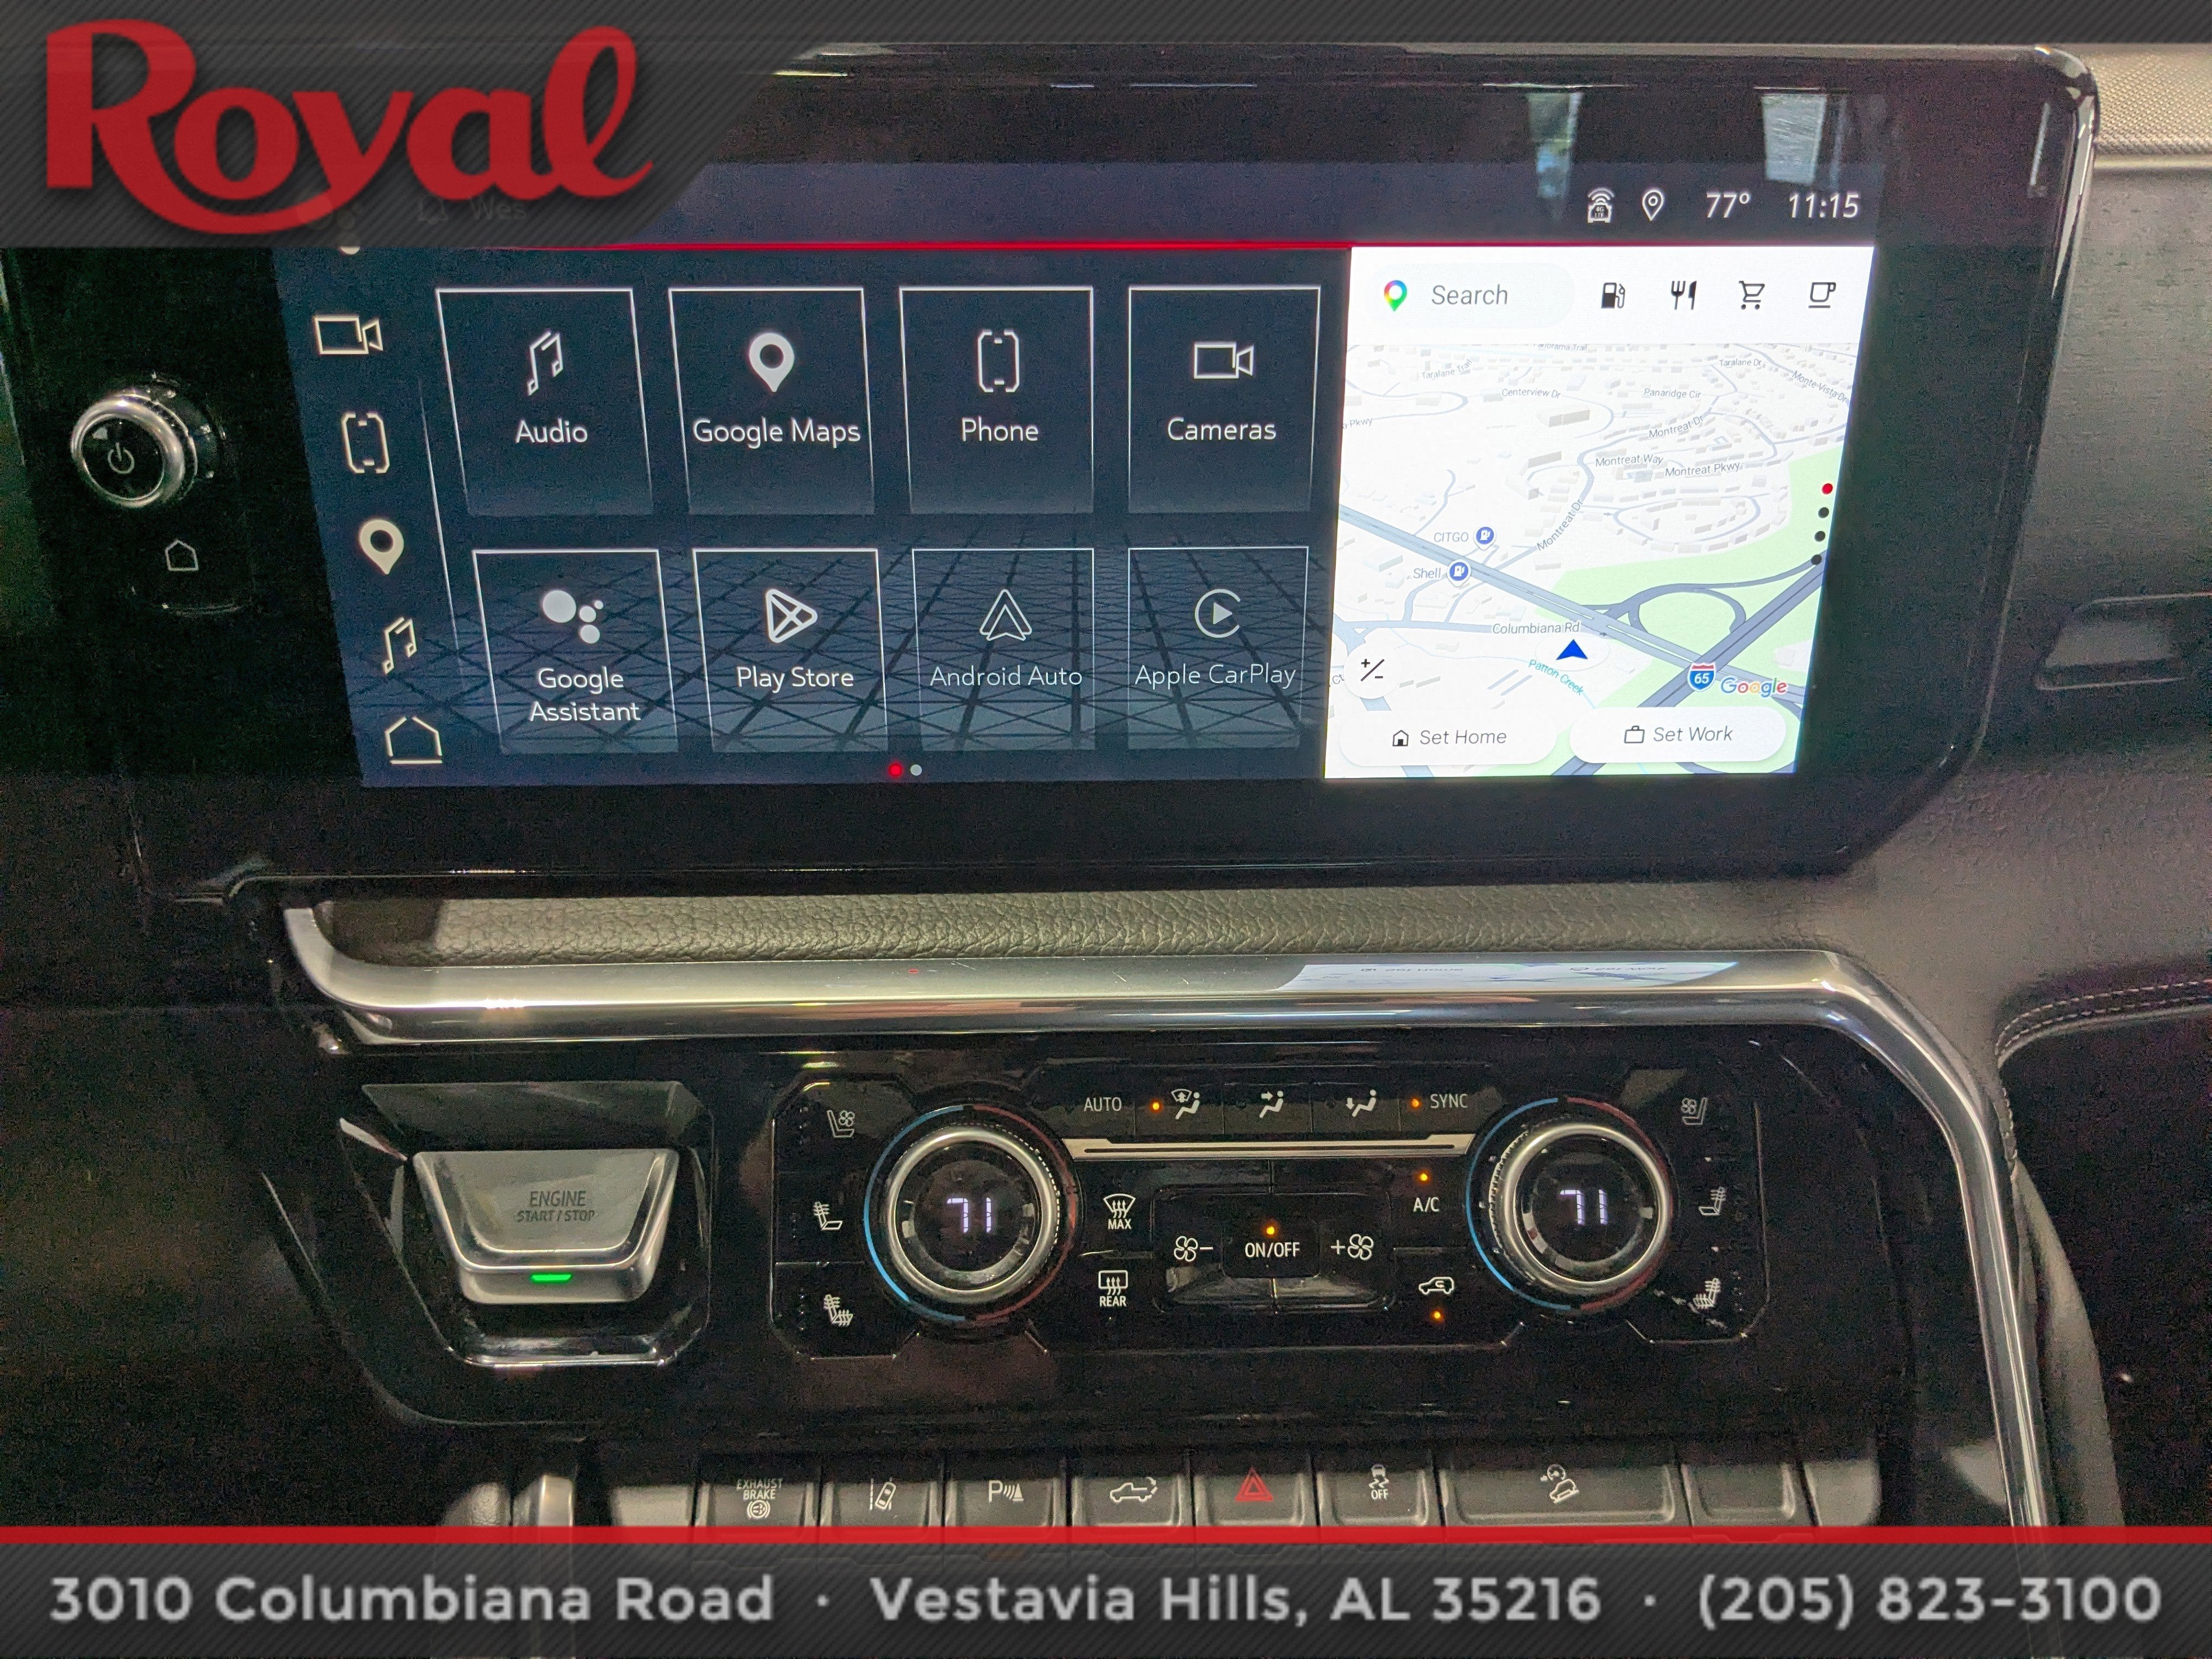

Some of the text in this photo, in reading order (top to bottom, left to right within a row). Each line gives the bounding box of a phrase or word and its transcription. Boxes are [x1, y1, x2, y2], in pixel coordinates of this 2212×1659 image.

[1707, 192, 1751, 218] 77°
[1788, 192, 1860, 218] 11:15
[1431, 285, 1508, 306] Search
[1421, 359, 1472, 379] Taralane Trail
[1753, 359, 1762, 367] Dr
[1502, 388, 1561, 399] Centerview Dr
[1644, 388, 1687, 400] Panaridge
[1792, 370, 1847, 402] Monte Vista Dr
[516, 418, 588, 443] Audio
[961, 418, 1039, 442] Phone
[1167, 417, 1277, 441] Cameras
[1350, 418, 1373, 428] Pkwy
[1649, 415, 1704, 438] Montreat Dr
[692, 417, 861, 449] Google Maps
[1595, 454, 1663, 466] Montreat Way
[1665, 462, 1740, 476] Montreat Pkwy
[1537, 499, 1583, 551] Montreat Dr
[1433, 532, 1469, 542] CITGO
[1413, 567, 1441, 579] Shell
[1492, 622, 1580, 634] Columbiana Rd
[538, 667, 624, 694] Google
[736, 666, 855, 693] Play Store
[930, 665, 1083, 686] Android Auto
[1135, 663, 1297, 690] Apple CarPlay
[1528, 659, 1584, 696] Patton Creek
[1695, 673, 1710, 684] 65
[1720, 677, 1787, 697] Google
[529, 701, 641, 721] Assistant
[1420, 729, 1507, 745] Set Home
[1653, 725, 1734, 742] Set Work
[1084, 1097, 1122, 1112] AUTO
[1430, 1094, 1468, 1109] SYNC
[529, 1190, 586, 1206] ENGINE
[1413, 1198, 1440, 1212] A/C
[946, 1197, 992, 1233] 71
[1559, 1189, 1609, 1225] 71
[1108, 1218, 1132, 1231] MAX
[1245, 1243, 1300, 1259] ON/OFF
[1099, 1295, 1127, 1307] REAR
[737, 1479, 783, 1490] EXHAUST
[743, 1489, 776, 1500] BRAKE
[1371, 1488, 1389, 1500] OFF
